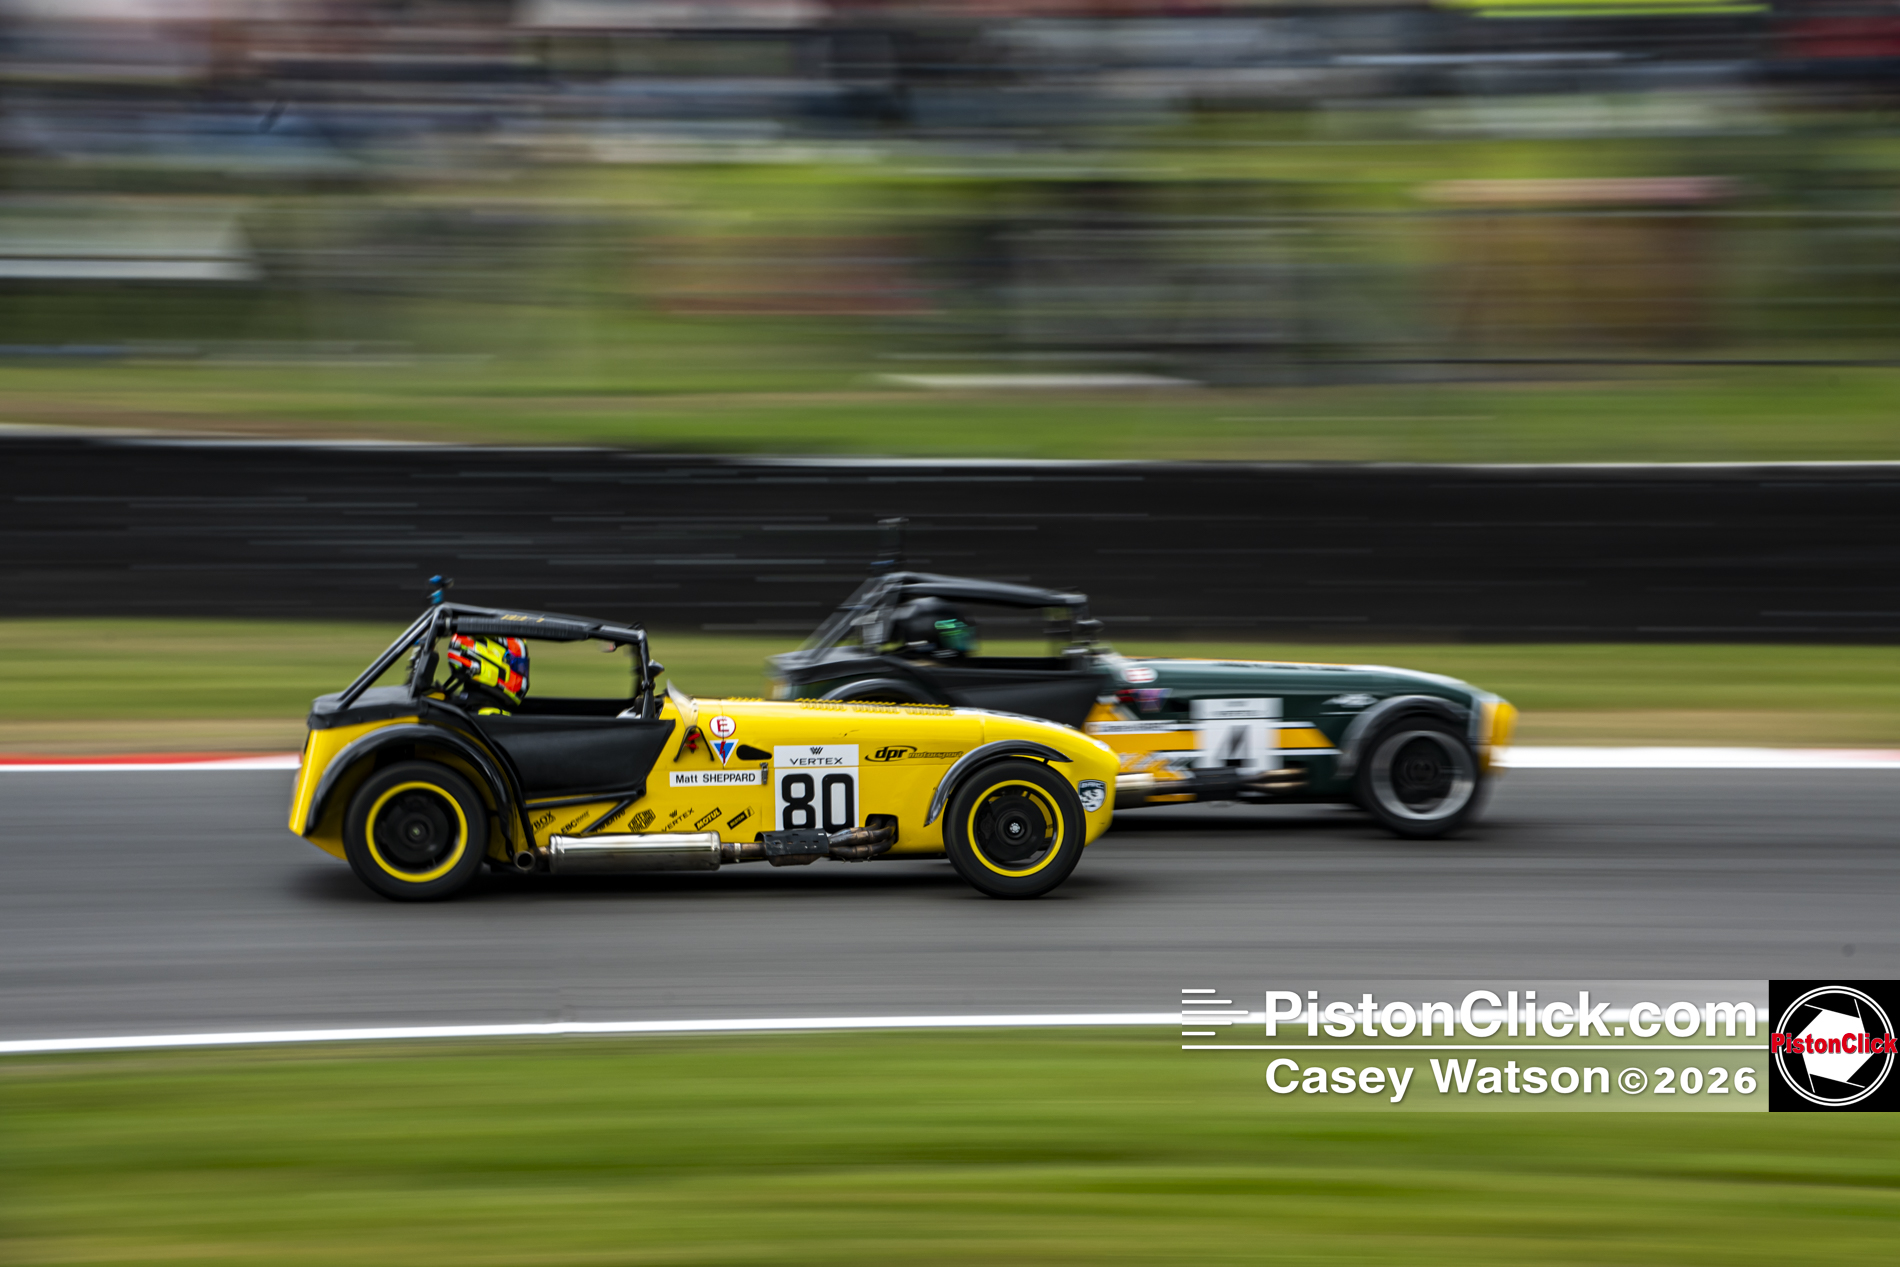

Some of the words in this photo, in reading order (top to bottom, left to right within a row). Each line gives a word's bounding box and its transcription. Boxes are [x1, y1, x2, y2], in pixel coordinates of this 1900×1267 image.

[716, 718, 730, 733] E
[789, 756, 844, 766] VERTEX
[874, 746, 908, 762] dpr
[675, 773, 698, 784] Matt
[702, 772, 756, 784] SHEPPARD
[781, 772, 855, 834] 80
[661, 807, 695, 832] VERTEX
[696, 809, 721, 829] MOTUL
